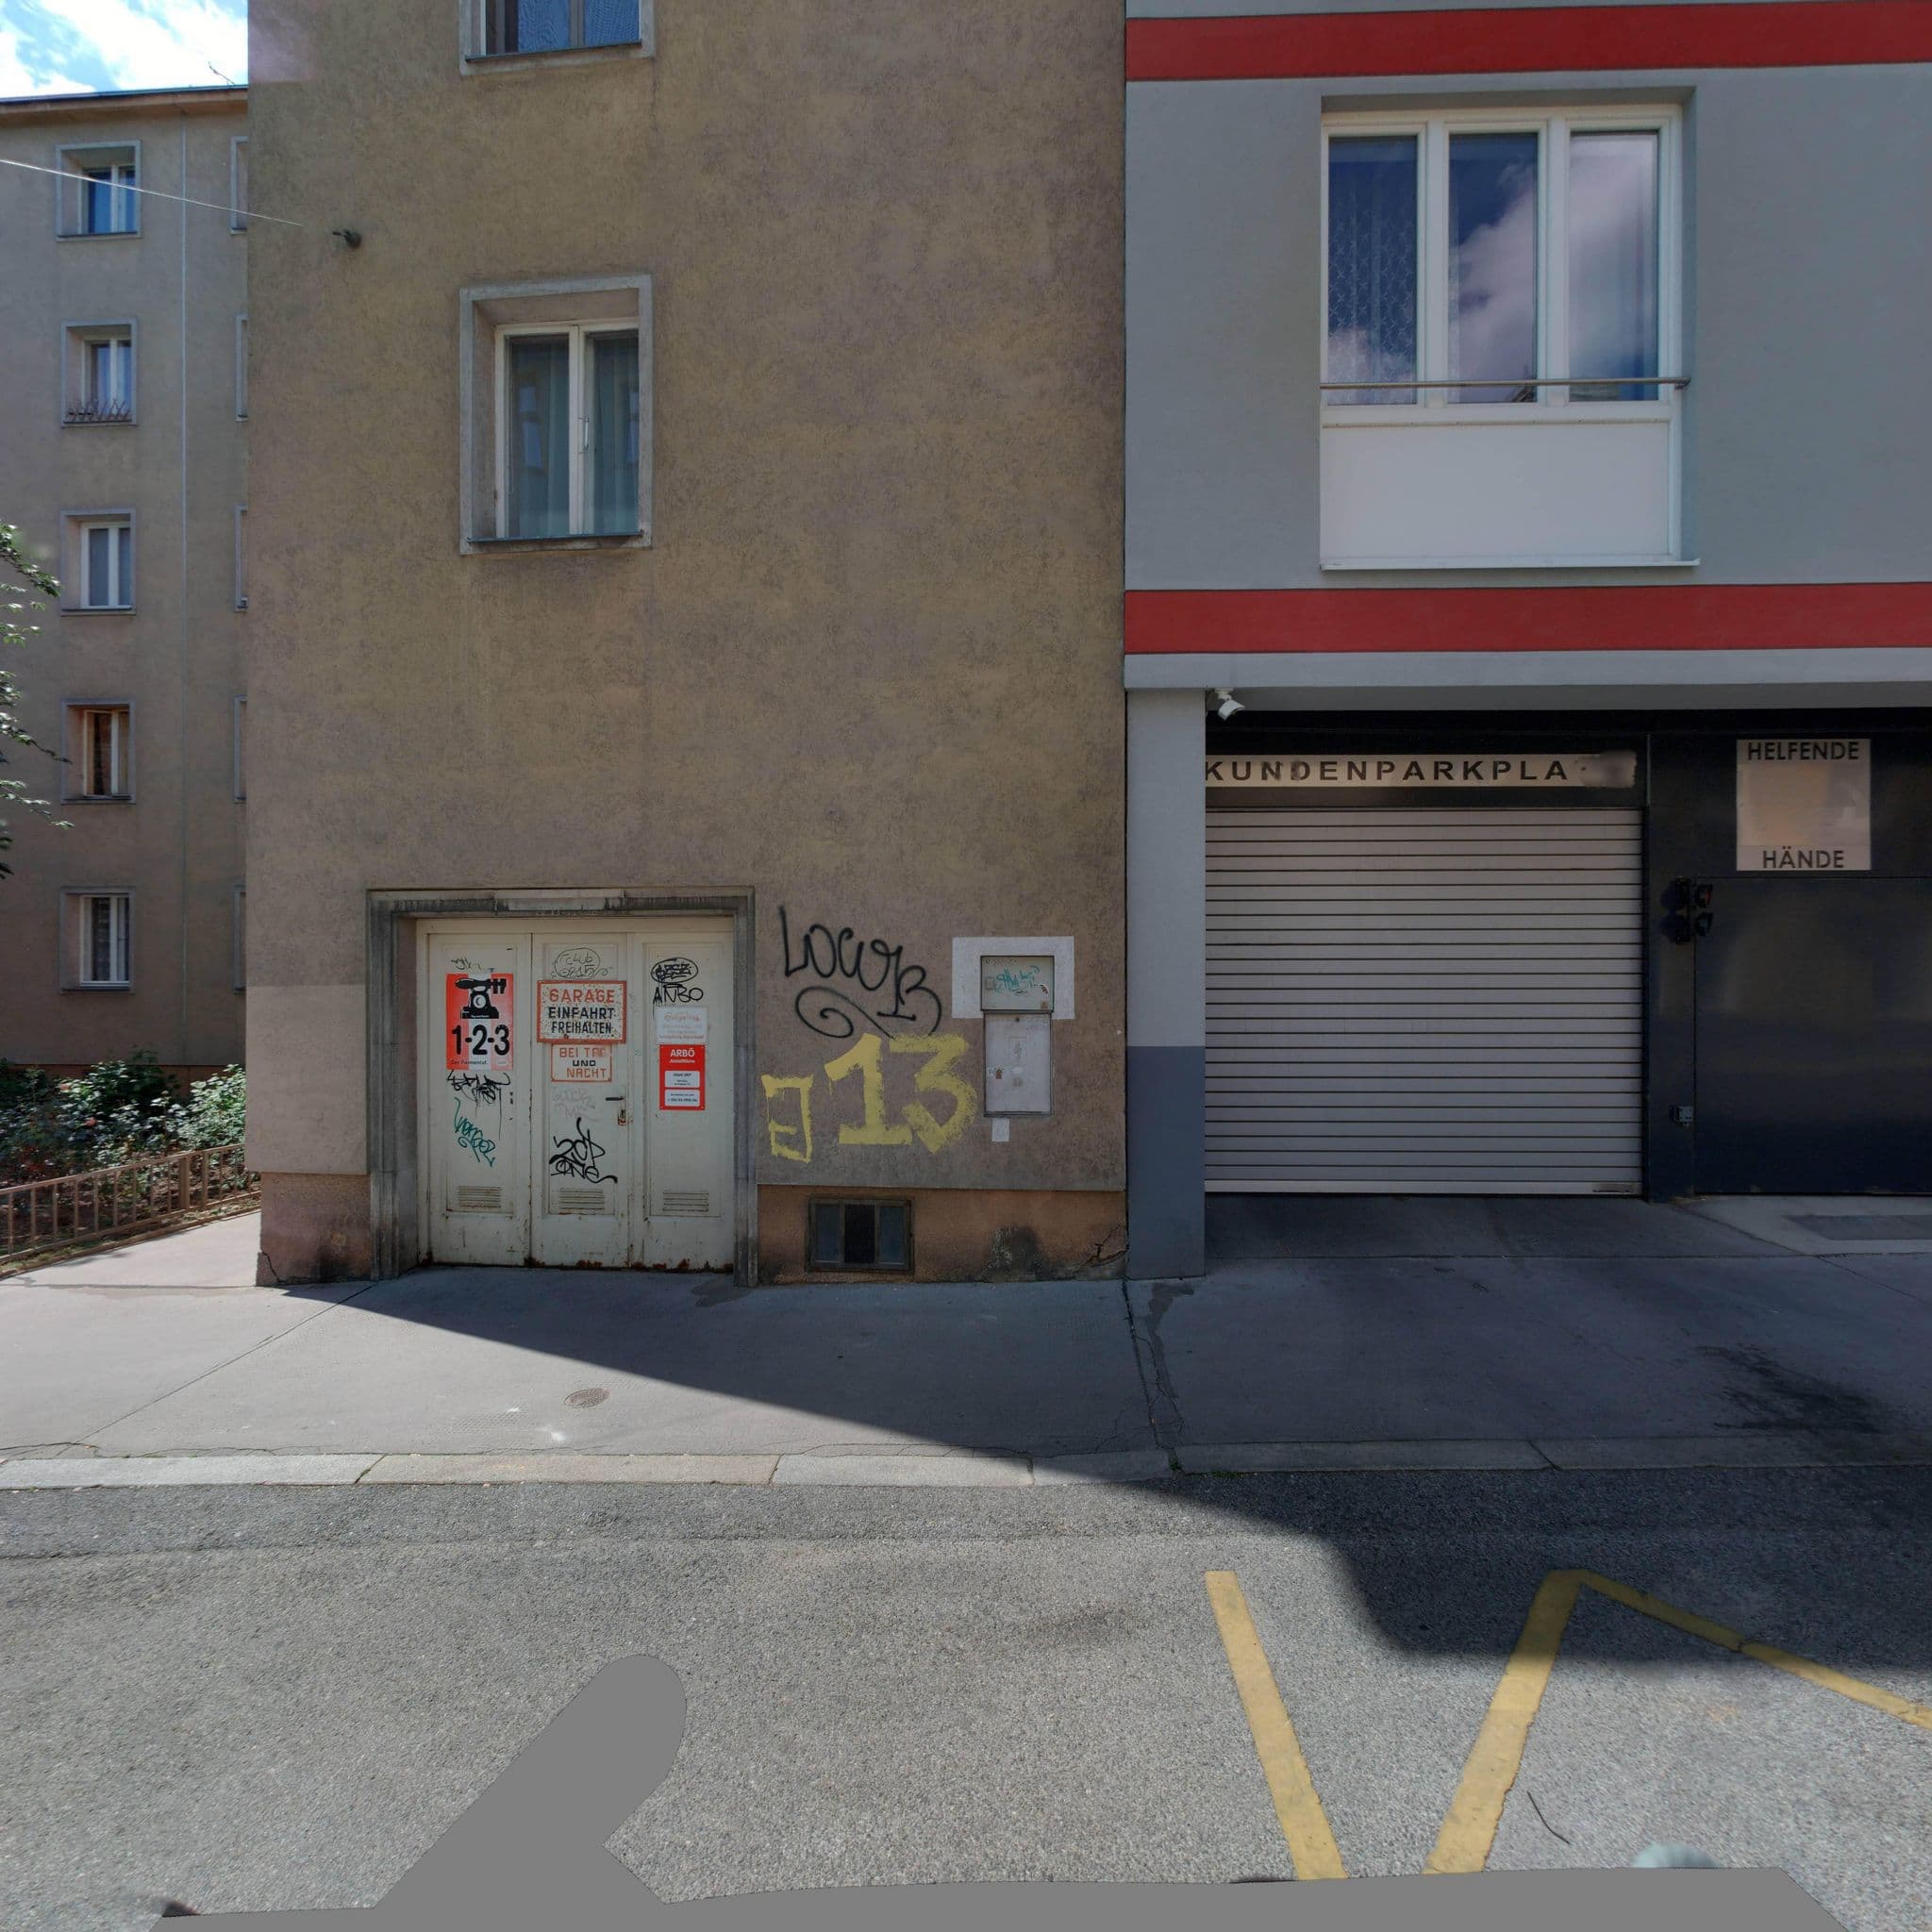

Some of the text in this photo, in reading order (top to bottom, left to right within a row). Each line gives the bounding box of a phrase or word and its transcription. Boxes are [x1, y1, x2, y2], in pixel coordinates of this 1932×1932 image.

[1747, 741, 1860, 761] HELFENDE
[1762, 845, 1845, 869] HÄNDE
[548, 988, 616, 1004] GARAGE
[548, 1006, 615, 1020] EINFAHRT
[551, 1020, 612, 1035] FREIHALTEN
[451, 1024, 511, 1056] 1-2-3
[558, 1046, 579, 1058] BEI
[670, 1047, 696, 1058] ARBÖ
[572, 1058, 597, 1068] UND
[566, 1067, 608, 1079] NACHT
